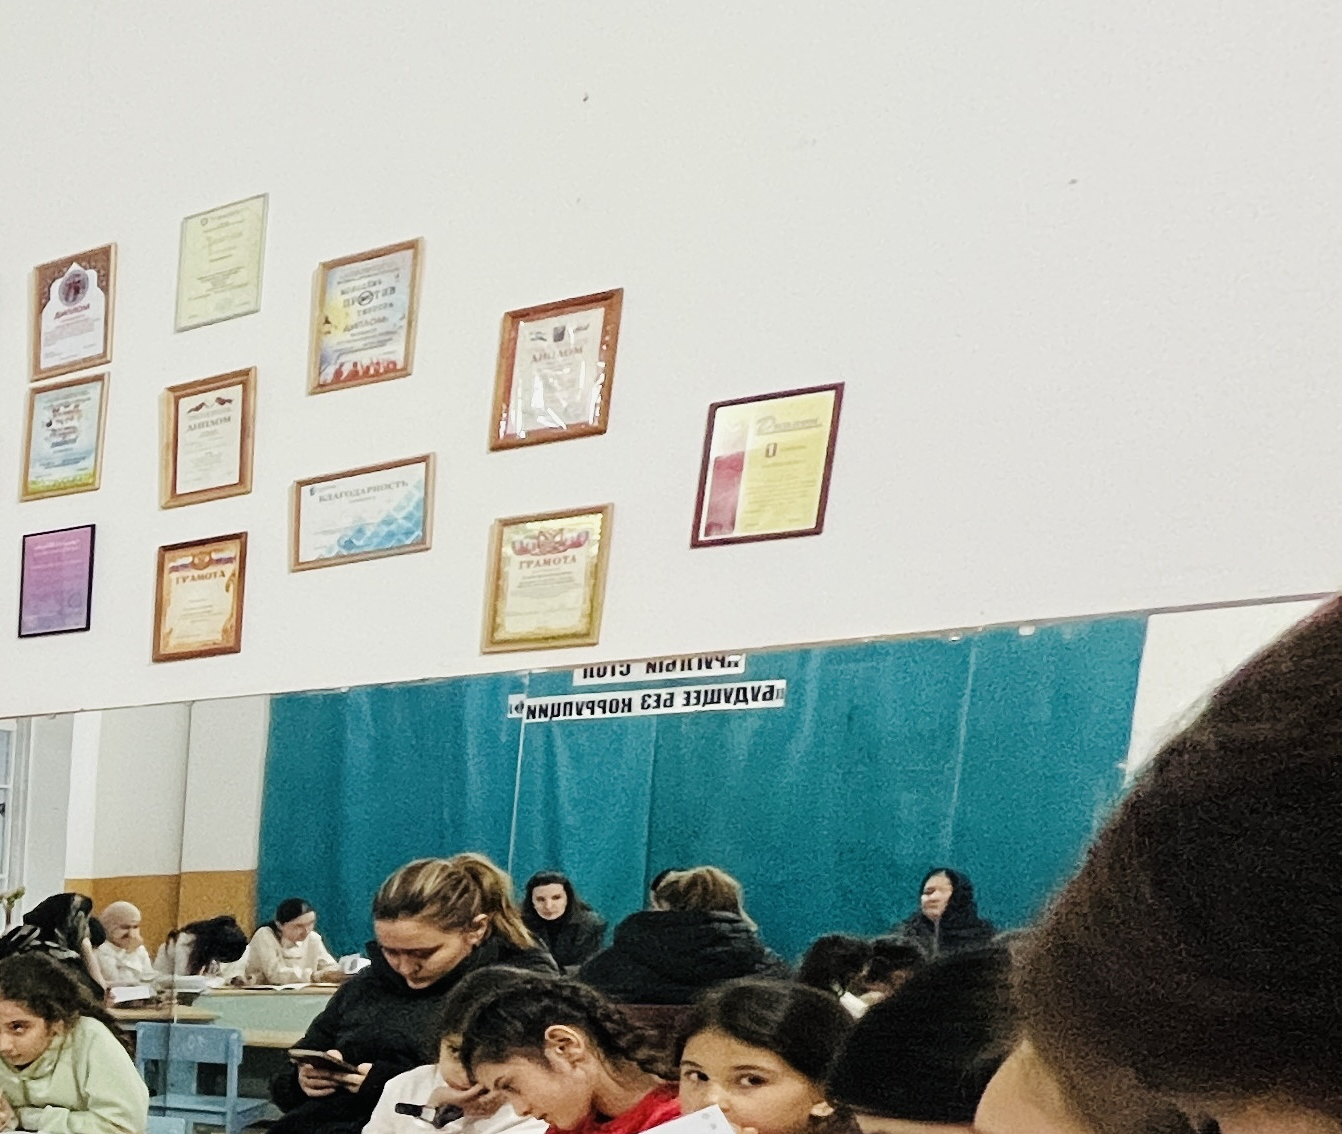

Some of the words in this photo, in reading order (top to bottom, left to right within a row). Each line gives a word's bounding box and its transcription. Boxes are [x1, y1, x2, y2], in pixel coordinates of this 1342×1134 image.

[318, 479, 409, 503] БЛАГОДАРНОСТЬ
[518, 554, 578, 570] ГРАМОТА
[175, 569, 226, 585] ГРАМОТА
